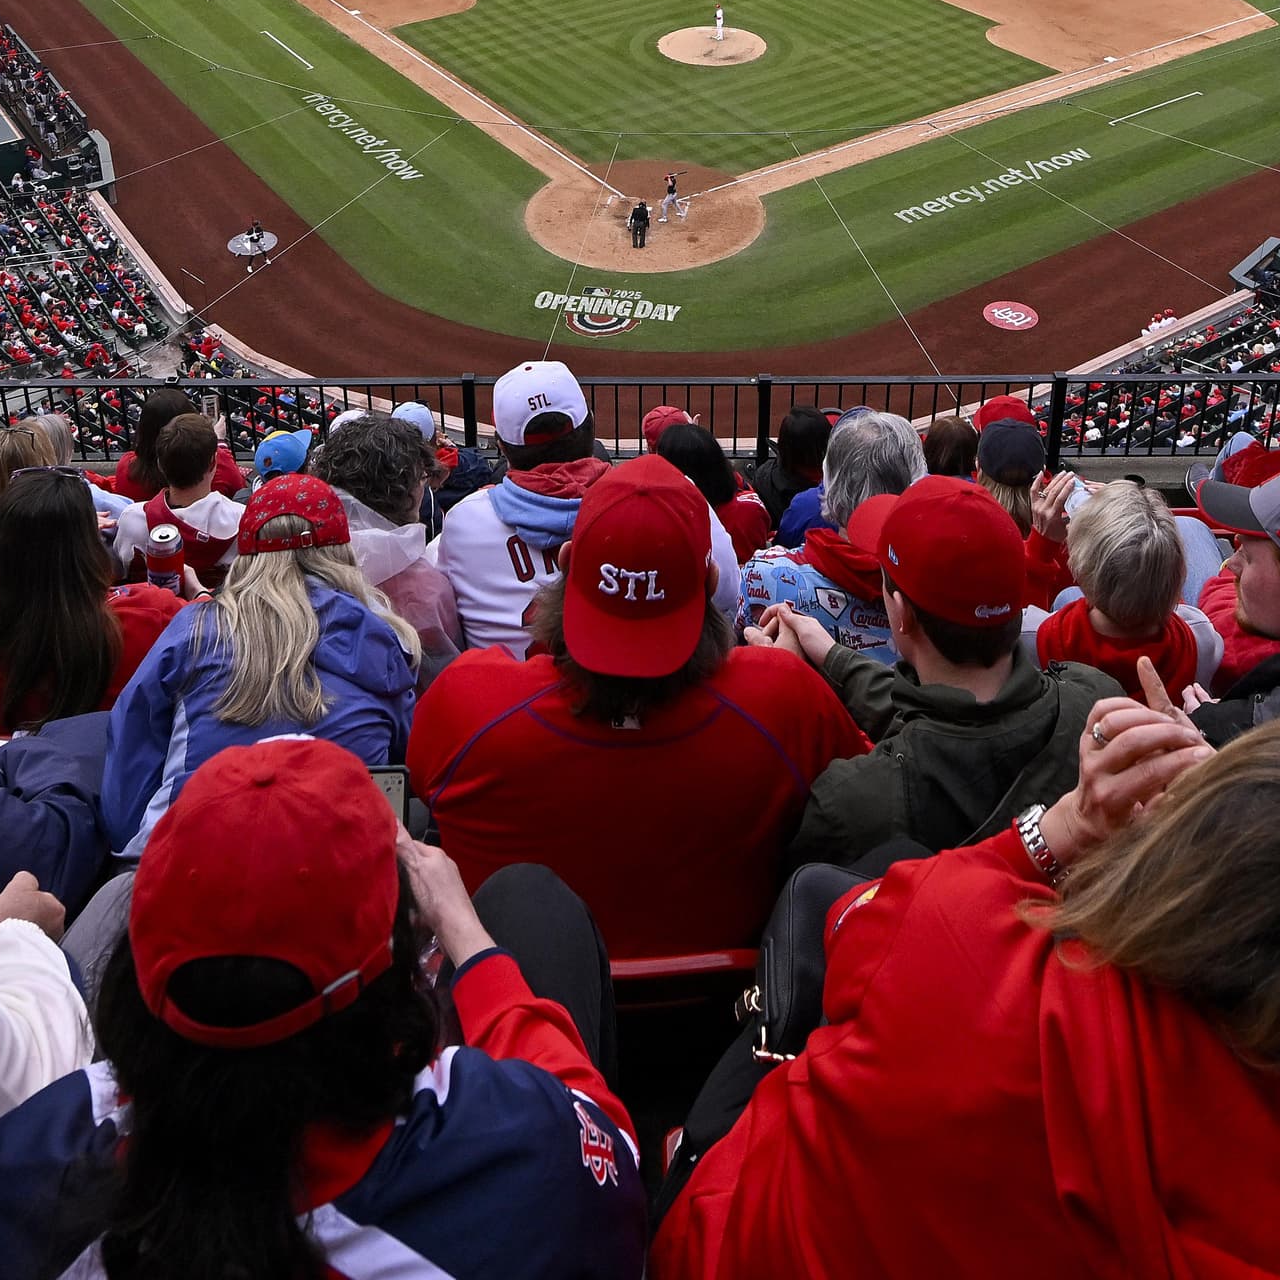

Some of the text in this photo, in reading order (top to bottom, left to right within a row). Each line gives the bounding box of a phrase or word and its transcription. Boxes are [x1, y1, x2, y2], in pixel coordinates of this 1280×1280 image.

[302, 93, 424, 180] mercy.net/now
[894, 147, 1091, 223] mercy.net/now
[534, 291, 681, 322] OPENING DAY
[613, 289, 642, 300] 2025
[527, 392, 552, 412] STL
[598, 563, 665, 601] STL
